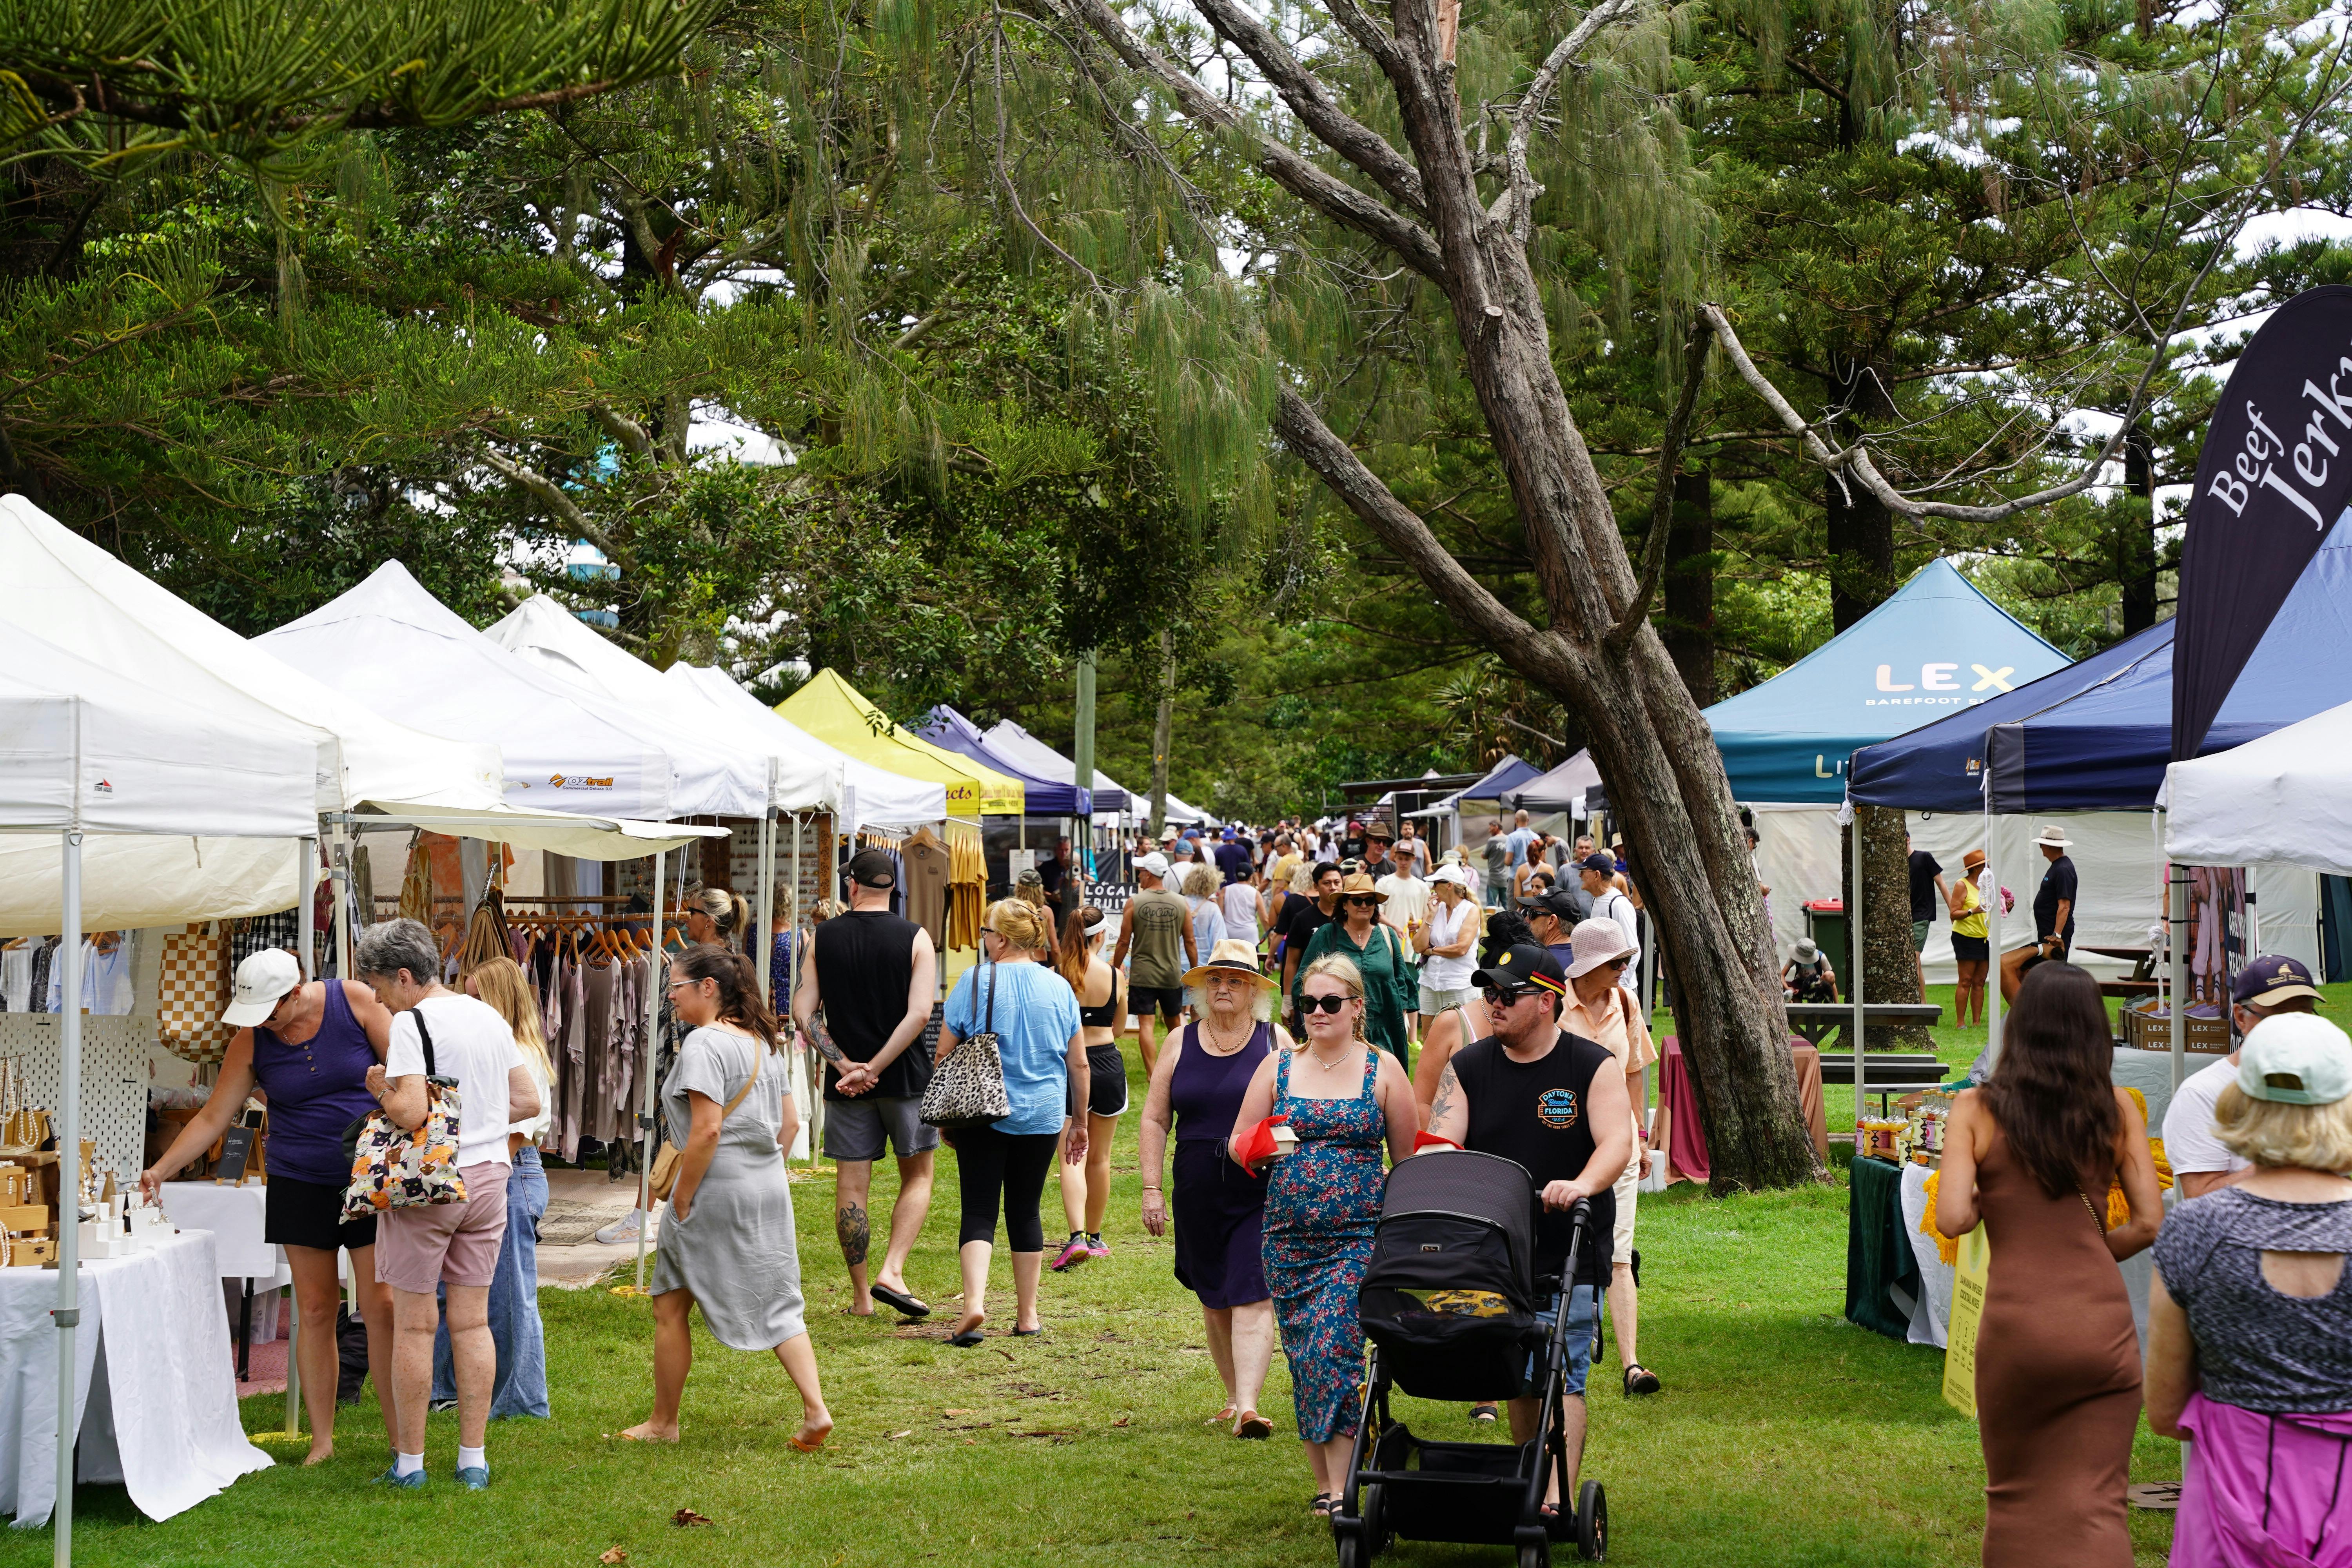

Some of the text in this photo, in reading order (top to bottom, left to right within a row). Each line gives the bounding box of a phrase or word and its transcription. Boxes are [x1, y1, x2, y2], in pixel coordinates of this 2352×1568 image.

[2207, 400, 2284, 518] Beef
[1876, 663, 2014, 692] LEX
[1866, 697, 1961, 706] BAREFOOT
[568, 777, 613, 786] OZtrail
[1085, 886, 1138, 897] LOCAL
[1142, 906, 1175, 919] Rip Curl
[2229, 910, 2239, 938] ARE
[1542, 1091, 1573, 1102] DAYTONA
